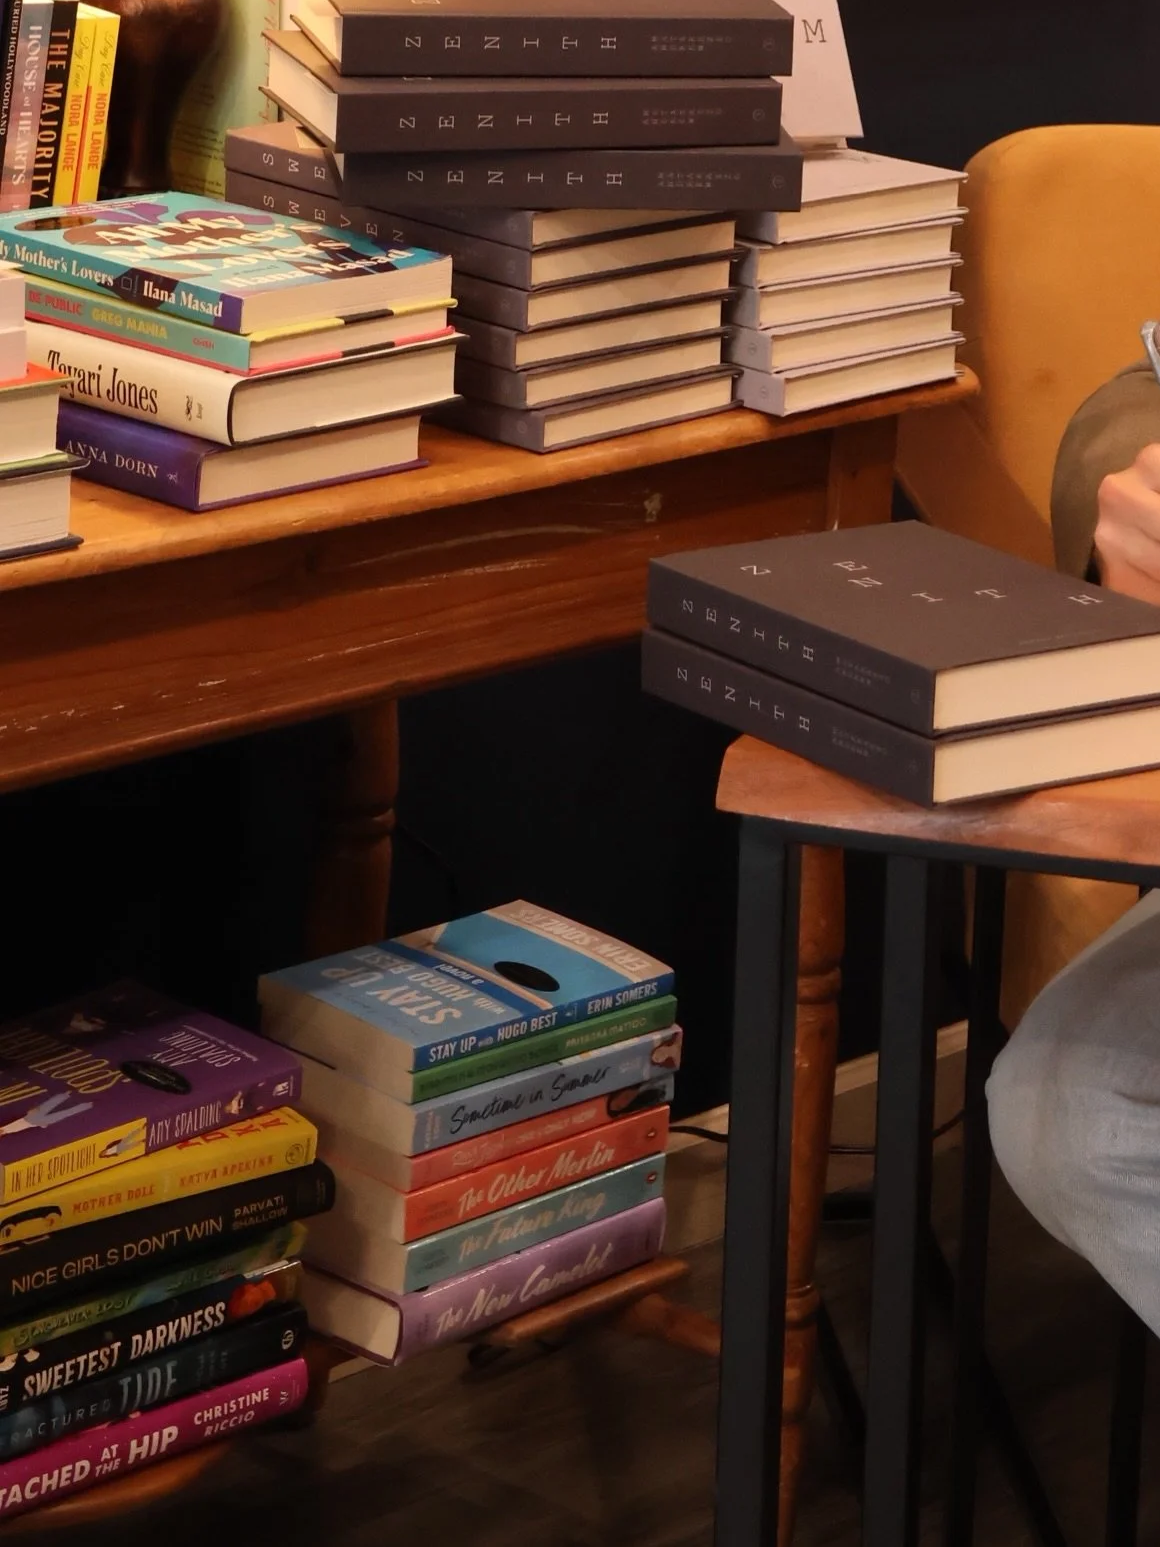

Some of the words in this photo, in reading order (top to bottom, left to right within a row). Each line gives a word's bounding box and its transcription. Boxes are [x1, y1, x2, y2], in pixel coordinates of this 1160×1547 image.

[21, 24, 43, 93] HOUSE
[46, 28, 71, 71] THE
[405, 35, 617, 51] ZENITH
[0, 36, 18, 137] HOLLYWOODLAND
[67, 94, 83, 128] NORA
[92, 92, 109, 127] NORA
[399, 110, 609, 129] ZENITH
[11, 110, 33, 186] HEARTS
[30, 82, 64, 200] MAJORITY
[61, 132, 79, 173] LANGE
[86, 130, 103, 172] LANGE
[407, 169, 623, 186] ZENITH
[94, 217, 175, 247] All
[173, 212, 247, 241] My
[263, 194, 405, 243] SWEVEN
[103, 219, 325, 264] Mother's
[174, 237, 354, 272] Lovers
[13, 244, 70, 273] Mother's
[70, 258, 115, 287] Lovers
[142, 278, 177, 303] Ilana
[179, 291, 224, 319] Masad
[220, 262, 313, 290] Ilana
[306, 247, 417, 281] Masad
[47, 293, 86, 316] PUBLIC
[90, 307, 124, 329] GREG
[125, 316, 168, 341] MANIA
[47, 349, 102, 400] Tayari
[106, 368, 159, 416] Jones
[65, 439, 109, 465] ANNA
[114, 454, 159, 480] DORN
[681, 598, 815, 662] ZENITH
[676, 667, 811, 733] ZENITH
[508, 908, 590, 944] SOMERS
[320, 965, 385, 989] UP
[432, 962, 470, 981] novel
[597, 941, 654, 974] ERIN
[366, 984, 463, 1027] STAY
[407, 970, 472, 1006] HUGO
[586, 995, 614, 1015] ERIN
[615, 981, 659, 1005] SOMERS
[157, 1030, 243, 1069] SPALDING
[427, 1040, 457, 1064] STAY
[458, 1034, 478, 1054] UP
[497, 1017, 529, 1043] HUGO
[530, 1011, 558, 1033] BEST
[449, 1095, 529, 1136] Sometime
[529, 1088, 544, 1104] in
[550, 1066, 611, 1103] Summer
[149, 1120, 173, 1148] AMY
[174, 1101, 223, 1138] SPALDING
[11, 1171, 22, 1194] IN
[25, 1163, 44, 1187] HER
[47, 1143, 97, 1182] SPOTLIGHT
[457, 1187, 485, 1220] The
[487, 1165, 544, 1205] Other
[548, 1140, 617, 1188] Merlin
[71, 1193, 123, 1214] MOTHER
[178, 1168, 218, 1188] KATYA
[233, 1194, 285, 1219] PARVATI
[231, 1205, 289, 1231] SHALLOW
[458, 1235, 484, 1263] The
[483, 1217, 556, 1251] Future
[556, 1190, 608, 1223] King
[11, 1266, 57, 1296] NICE
[61, 1247, 120, 1281] GIRLS
[123, 1228, 182, 1260] DON'T
[185, 1215, 224, 1241] WIN
[434, 1308, 464, 1340] The
[462, 1285, 519, 1328] New
[519, 1242, 614, 1303] Camelot
[22, 1340, 122, 1402] SWEETEST
[129, 1301, 227, 1361] DARKNESS
[119, 1359, 178, 1413] TIDE
[193, 1386, 271, 1427] CHRISTINE
[126, 1424, 179, 1465] HIP
[203, 1410, 256, 1438] RICCIO
[94, 1457, 121, 1478] THE
[100, 1443, 120, 1462] AT
